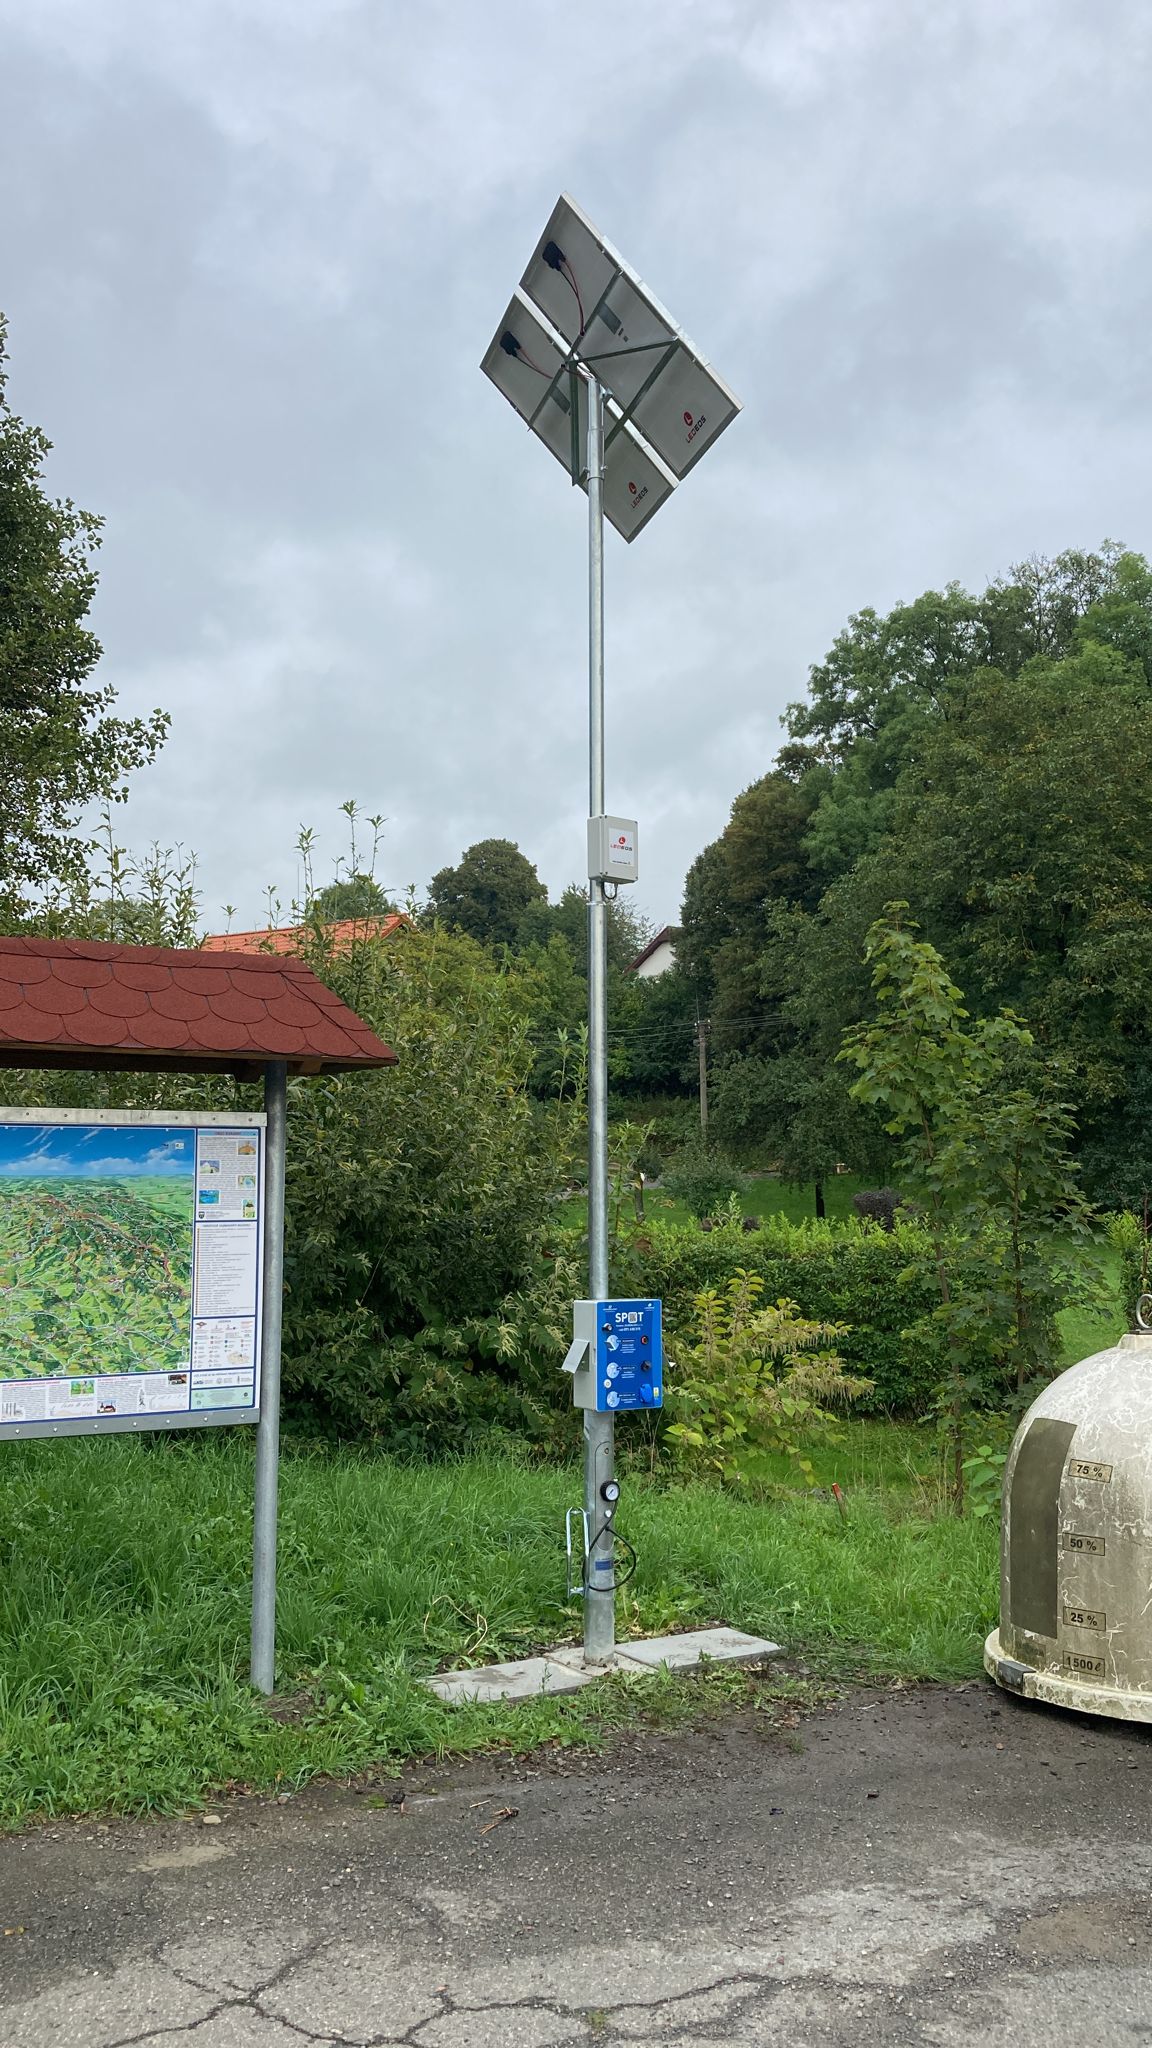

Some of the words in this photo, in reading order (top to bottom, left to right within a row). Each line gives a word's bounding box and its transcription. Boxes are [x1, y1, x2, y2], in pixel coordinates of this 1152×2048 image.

[615, 1311, 644, 1324] SPOT
[1076, 1464, 1090, 1475] 75
[1093, 1466, 1103, 1478] %
[1070, 1538, 1083, 1549] 50
[1086, 1540, 1097, 1552] %
[1070, 1612, 1084, 1624] 25
[1087, 1614, 1098, 1627] %
